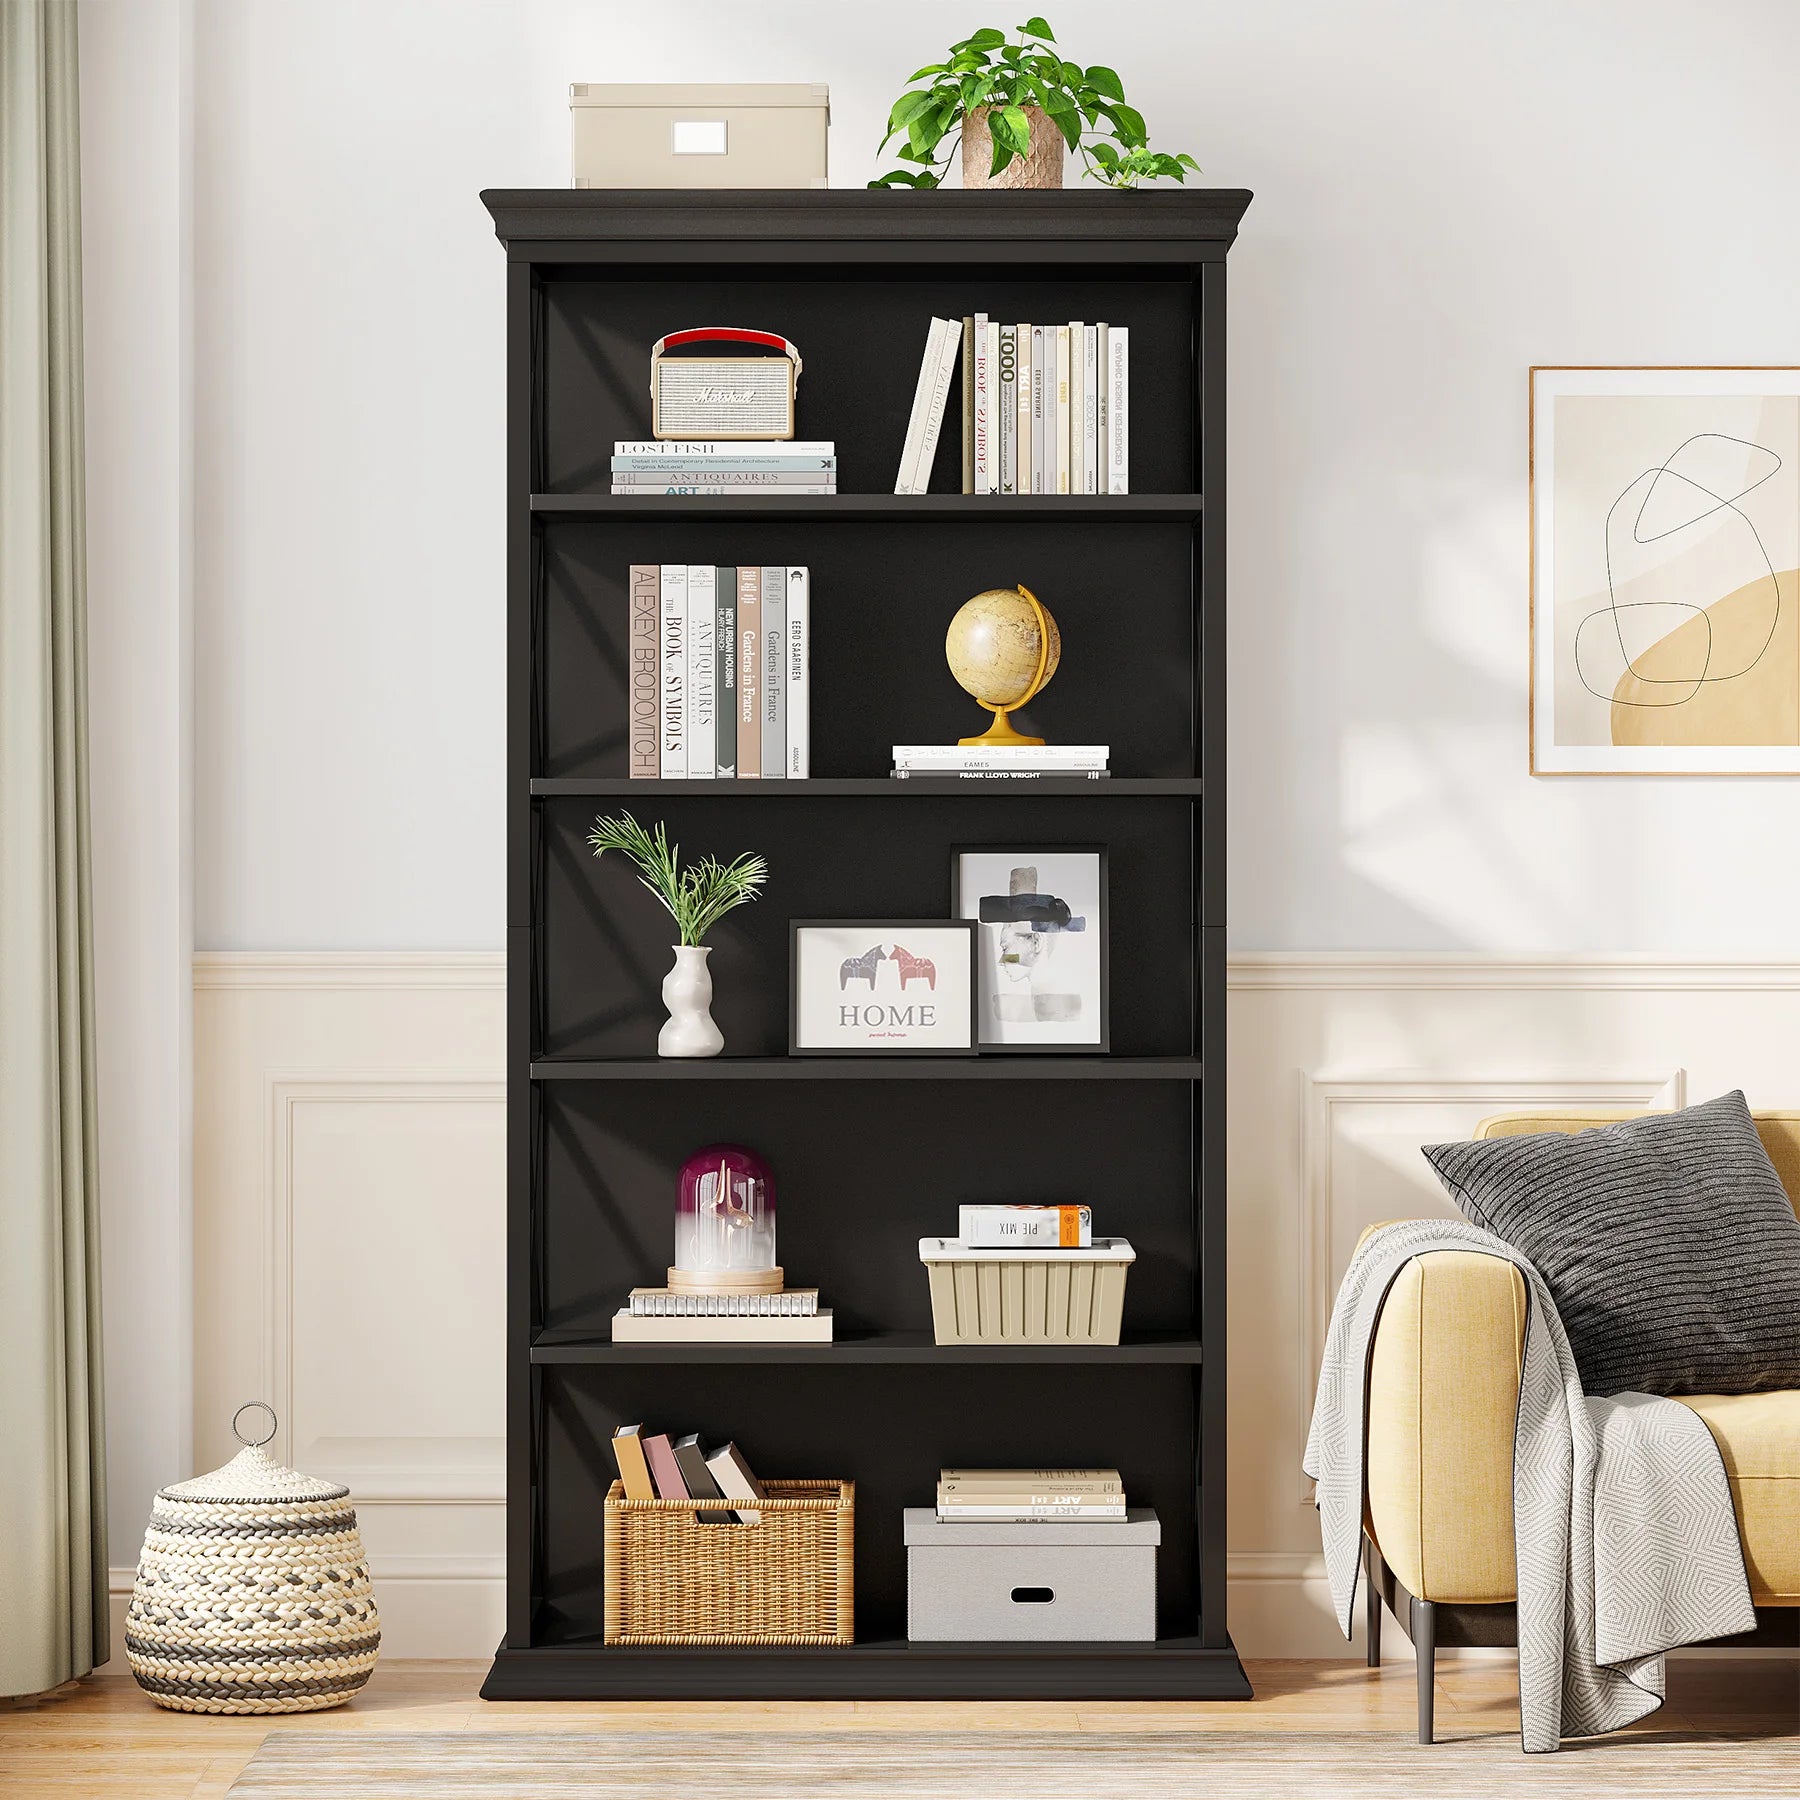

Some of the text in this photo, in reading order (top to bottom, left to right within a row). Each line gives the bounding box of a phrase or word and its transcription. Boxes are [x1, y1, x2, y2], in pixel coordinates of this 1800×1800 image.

[694, 387, 756, 404] Marshall
[622, 444, 714, 453] LOST FISH
[666, 617, 682, 659] BOOK
[792, 621, 801, 680] EERO SAARINEN
[634, 571, 656, 767] ALEXEY BRODOVITCH
[666, 663, 673, 672] OF
[696, 620, 712, 725] ANTIQUAIRES
[743, 631, 756, 722] Gardens in France
[768, 631, 780, 722] Gardens in France
[666, 676, 682, 751] SYMBOLS
[839, 1005, 936, 1026] HOME
[1000, 1223, 1038, 1235] PIE MIX
[1052, 1496, 1081, 1504] ART
